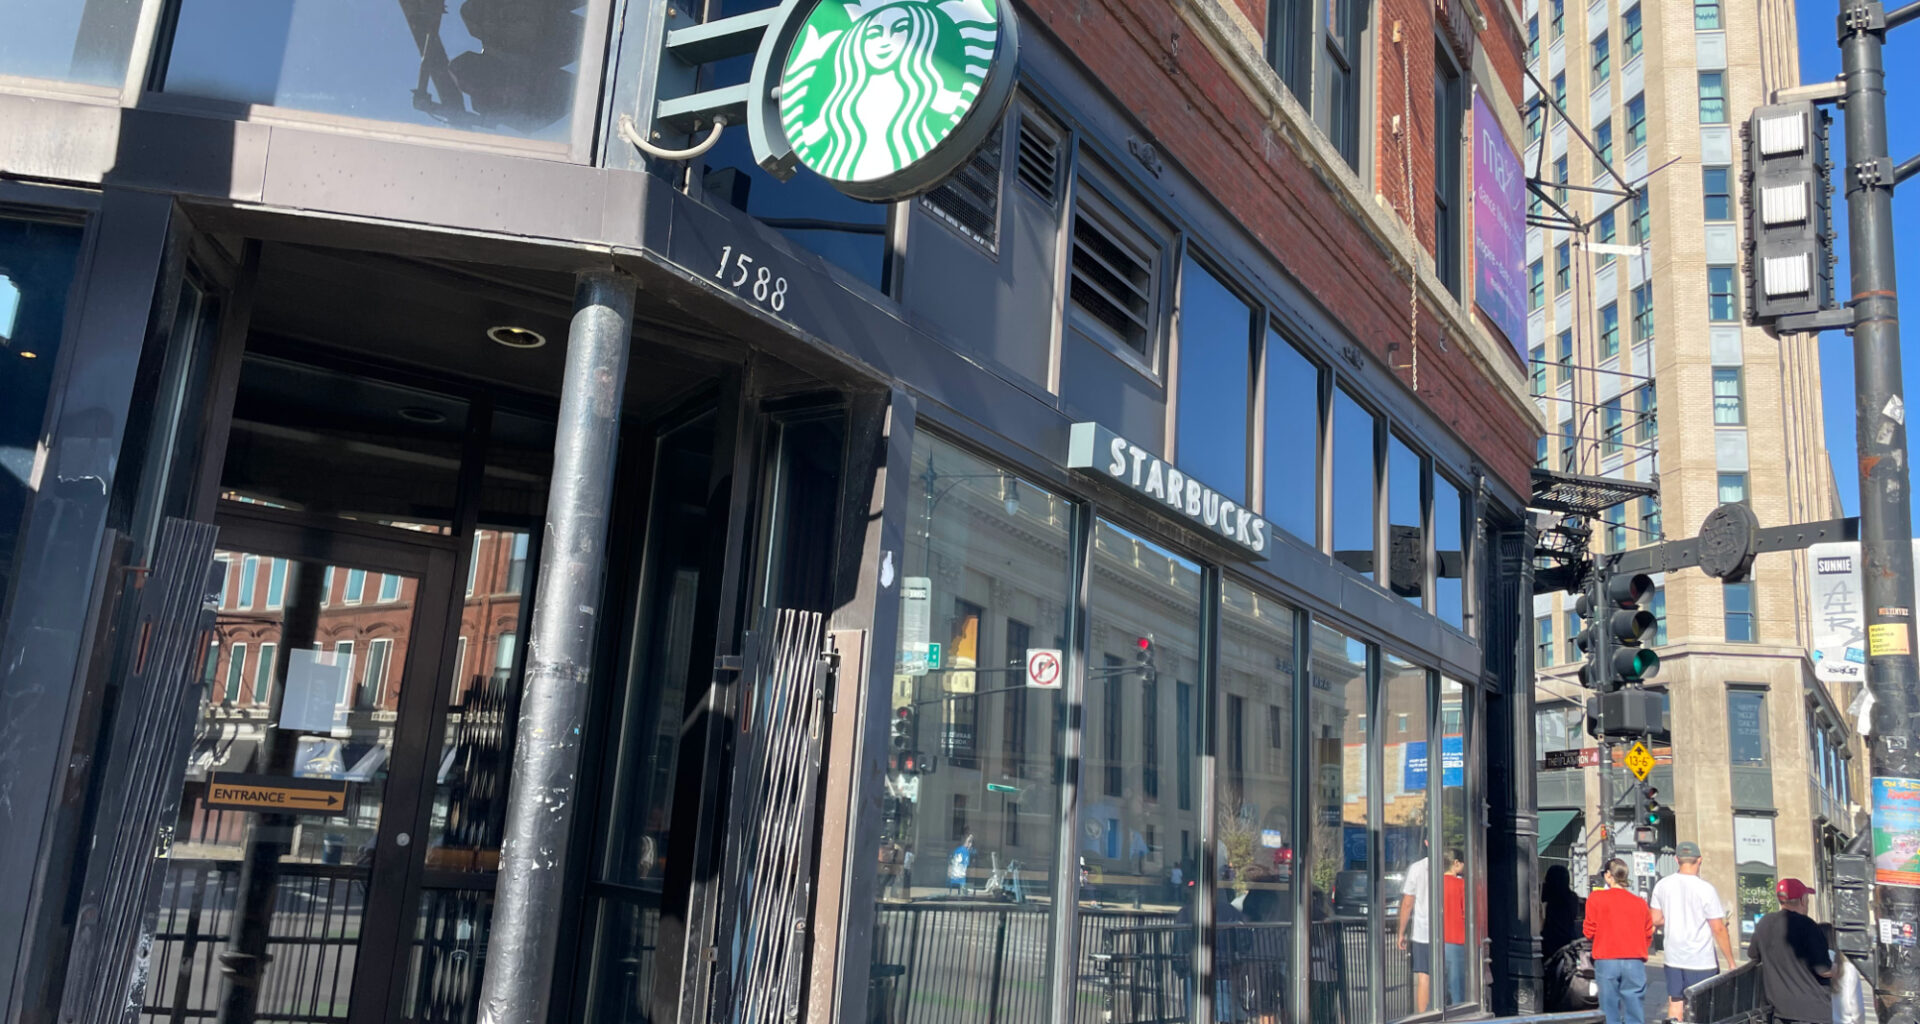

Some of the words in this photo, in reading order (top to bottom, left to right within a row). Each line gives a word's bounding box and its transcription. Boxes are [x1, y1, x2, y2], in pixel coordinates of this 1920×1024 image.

[715, 246, 788, 312] 1588
[1109, 437, 1265, 551] STARBUCKS
[1818, 559, 1851, 573] SUNNIE
[214, 788, 286, 803] ENTRANCE
